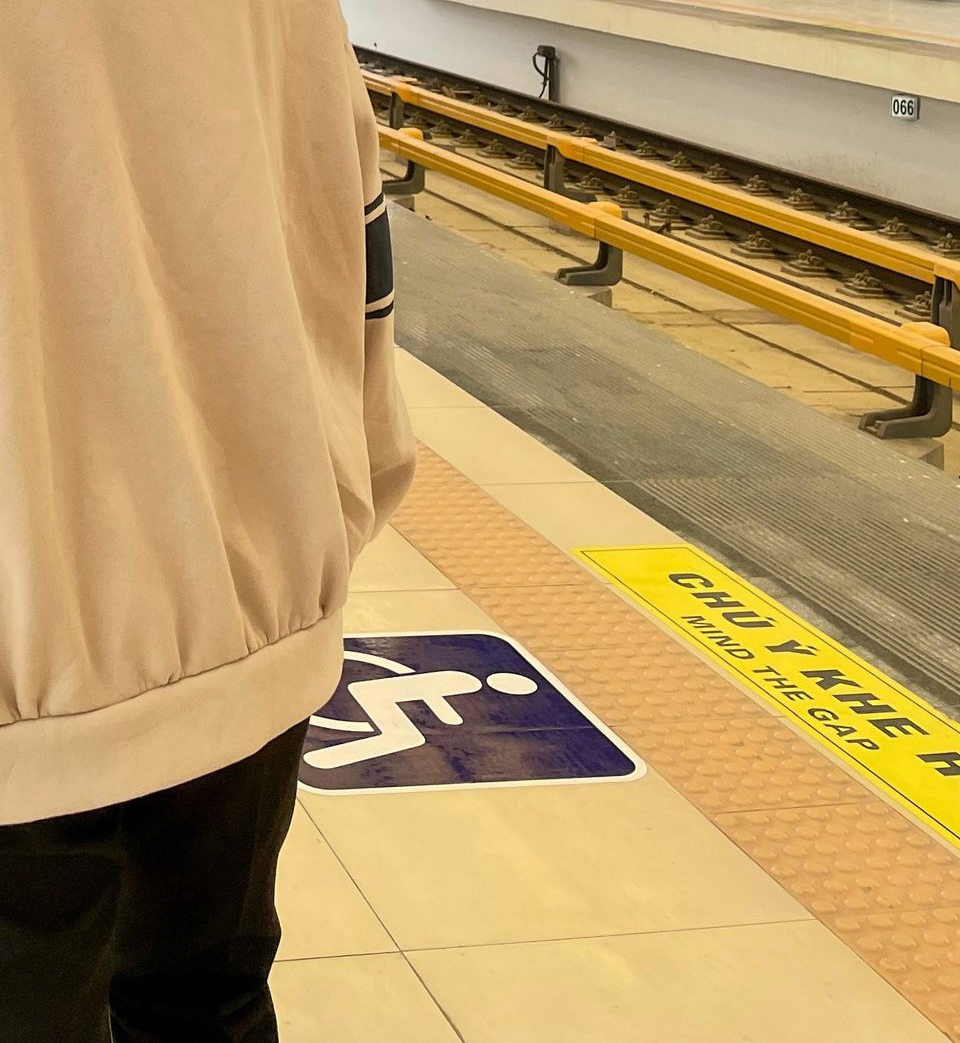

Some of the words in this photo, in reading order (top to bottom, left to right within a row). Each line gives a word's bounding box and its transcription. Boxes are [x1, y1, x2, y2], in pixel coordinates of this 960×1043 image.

[893, 99, 913, 115] 066
[668, 573, 776, 628] CHÚ
[764, 639, 818, 656] Ý
[800, 669, 930, 738] KHE
[681, 615, 755, 660] MIND
[753, 666, 814, 701] THE
[807, 708, 880, 750] GAP
